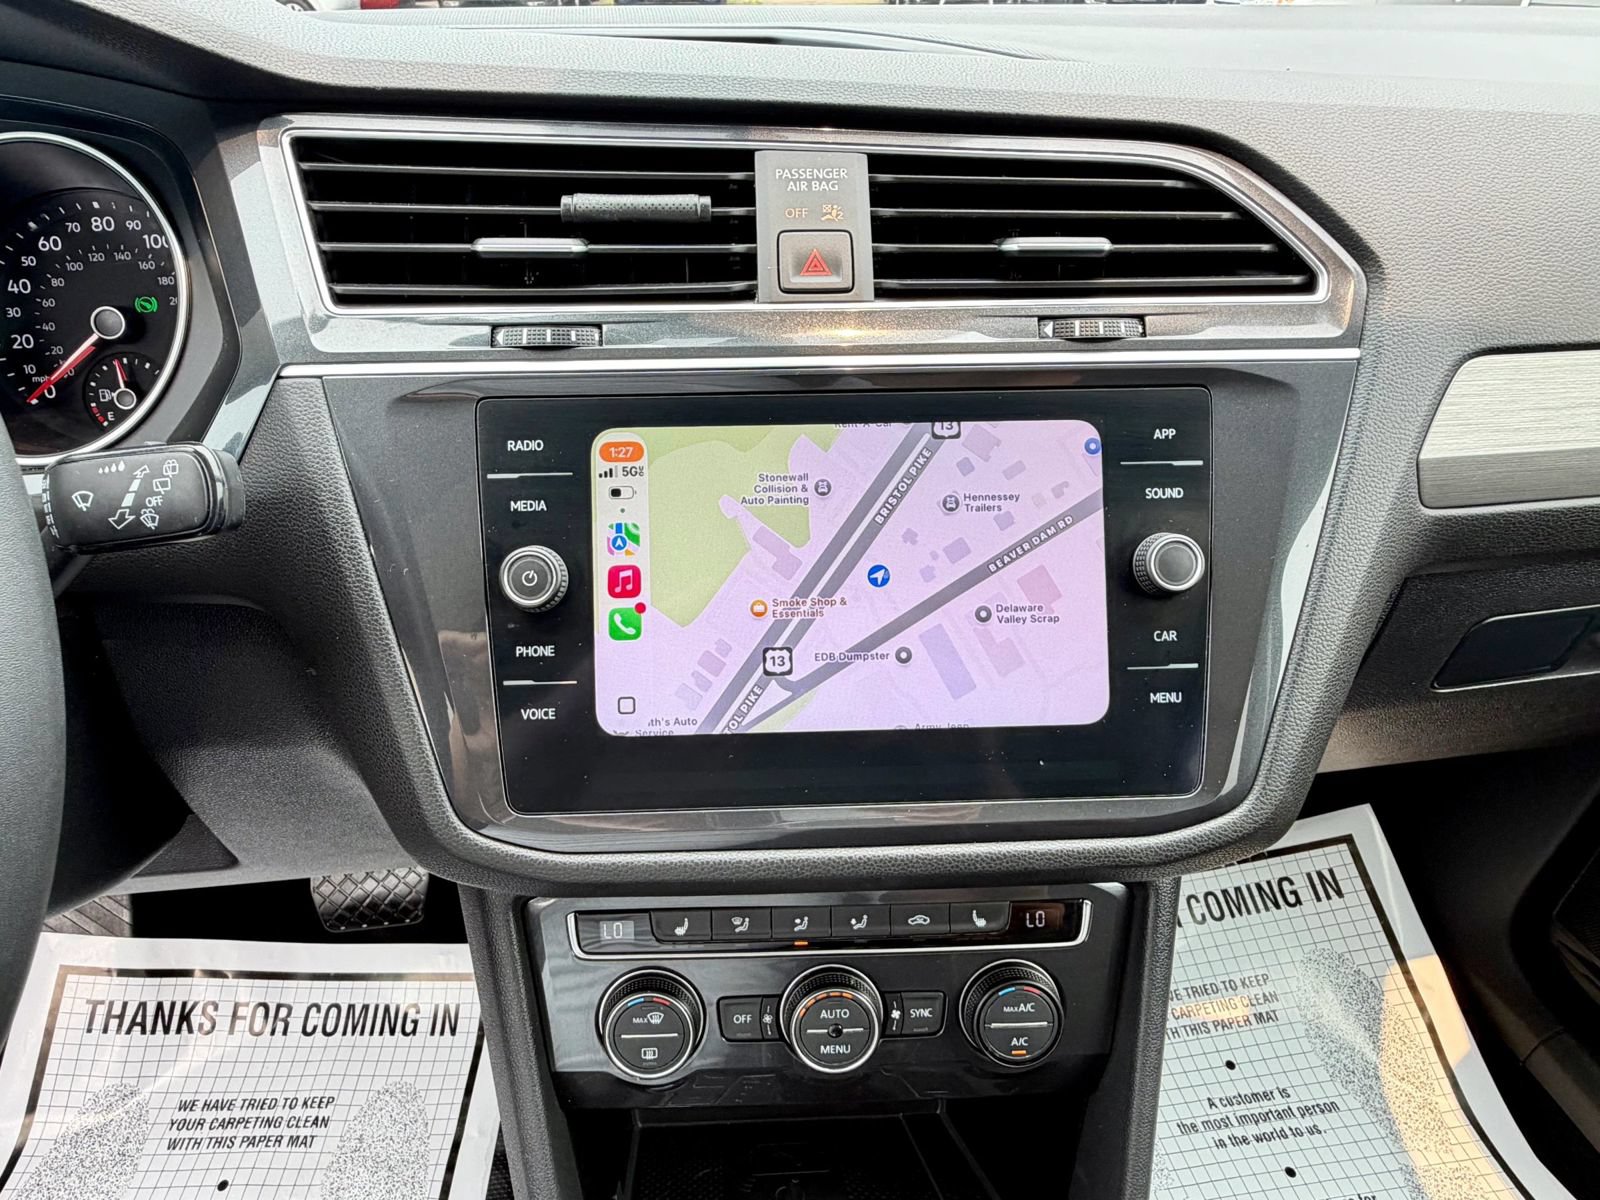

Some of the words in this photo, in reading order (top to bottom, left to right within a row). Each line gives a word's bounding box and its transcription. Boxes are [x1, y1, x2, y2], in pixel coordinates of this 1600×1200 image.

[775, 168, 848, 179] PASSENGER
[787, 181, 808, 191] AIR
[812, 180, 838, 191] BAG
[785, 208, 808, 218] OFF
[65, 222, 81, 233] 70
[91, 216, 115, 232] 80
[125, 220, 141, 231] 90
[38, 235, 62, 251] 60
[21, 256, 36, 266] 50
[88, 252, 105, 262] 120
[113, 251, 132, 260] 140
[65, 262, 83, 271] 100
[138, 260, 156, 270] 160
[7, 278, 31, 294] 40
[51, 277, 64, 287] 80
[157, 276, 174, 285] 180
[42, 298, 55, 307] 60
[5, 307, 21, 318] 30
[42, 322, 56, 331] 40
[11, 334, 34, 349] 20
[51, 346, 64, 355] 20
[23, 364, 36, 374] 10
[108, 411, 115, 421] E
[1153, 428, 1176, 439] APP
[507, 440, 544, 451] RADIO
[609, 446, 633, 458] 1:27
[758, 473, 808, 482] Stonewall
[754, 485, 798, 493] Collision
[801, 484, 808, 493] &
[875, 476, 913, 524] BRISTOL
[909, 448, 932, 476] PIKE
[963, 493, 1020, 502] Hennessey
[1145, 487, 1183, 499] SOUND
[145, 496, 163, 507] OFF
[510, 500, 547, 512] MEDIA
[740, 496, 764, 505] Auto
[767, 495, 809, 506] Painting
[964, 503, 1002, 512] Trailers
[988, 542, 1031, 573] BEAVER
[1031, 526, 1057, 546] DAM
[1057, 515, 1074, 530] RD
[772, 598, 807, 607] Smoke
[810, 597, 836, 608] Shop
[840, 597, 847, 606] &
[772, 609, 825, 618] Essentials
[996, 604, 1043, 613] Delaware
[996, 615, 1027, 625] Valley
[1030, 614, 1060, 625] Scrap
[1153, 630, 1177, 642] CAR
[515, 645, 555, 657] PHONE
[769, 656, 785, 667] 13
[814, 652, 836, 661] EDB
[838, 651, 890, 663] Dumpster
[740, 685, 763, 717] PIKE
[1150, 692, 1182, 703] MENU
[521, 708, 556, 720] VOICE
[673, 717, 698, 726] Auto
[1186, 876, 1303, 925] COMING
[1306, 867, 1344, 903] IN
[1026, 910, 1046, 928] LO
[603, 922, 623, 939] LO
[1183, 982, 1219, 1000] TRIED
[1220, 978, 1238, 992] TO
[1239, 973, 1269, 989] KEEP
[1018, 1003, 1035, 1012] A/C
[1171, 997, 1237, 1020] CARPETING
[1241, 990, 1280, 1008] CLEAN
[820, 1008, 850, 1019] AUTO
[909, 1007, 933, 1018] SYNC
[86, 1000, 219, 1036] THANKS
[228, 1001, 293, 1037] FOR
[301, 1002, 421, 1037] COMING
[429, 1003, 460, 1037] IN
[733, 1014, 752, 1024] OFF
[1180, 1021, 1211, 1038] THIS
[1212, 1014, 1252, 1032] PAPER
[1253, 1009, 1280, 1025] MAT
[1011, 1037, 1029, 1046] A/C
[820, 1044, 851, 1054] MENU
[1207, 1097, 1218, 1110] A
[1218, 1090, 1276, 1108] customer
[1278, 1086, 1291, 1099] is
[178, 1099, 199, 1112] WE
[201, 1098, 237, 1112] HAVE
[240, 1097, 278, 1111] TRIED
[283, 1096, 299, 1110] TO
[301, 1096, 335, 1109] KEEP
[169, 1118, 206, 1131] YOUR
[209, 1116, 284, 1131] CARPETING
[286, 1115, 330, 1129] CLEAN
[1177, 1121, 1199, 1135] the
[1201, 1114, 1234, 1132] most
[1235, 1105, 1296, 1126] important
[1297, 1100, 1340, 1119] person
[1212, 1136, 1227, 1150] in
[1228, 1132, 1250, 1147] the
[1251, 1127, 1289, 1144] world
[1290, 1125, 1304, 1138] to
[1306, 1123, 1327, 1136] us.
[167, 1137, 204, 1150] WITH
[206, 1136, 236, 1150] THIS
[239, 1135, 283, 1148] PAPER
[287, 1135, 317, 1148] MAT
